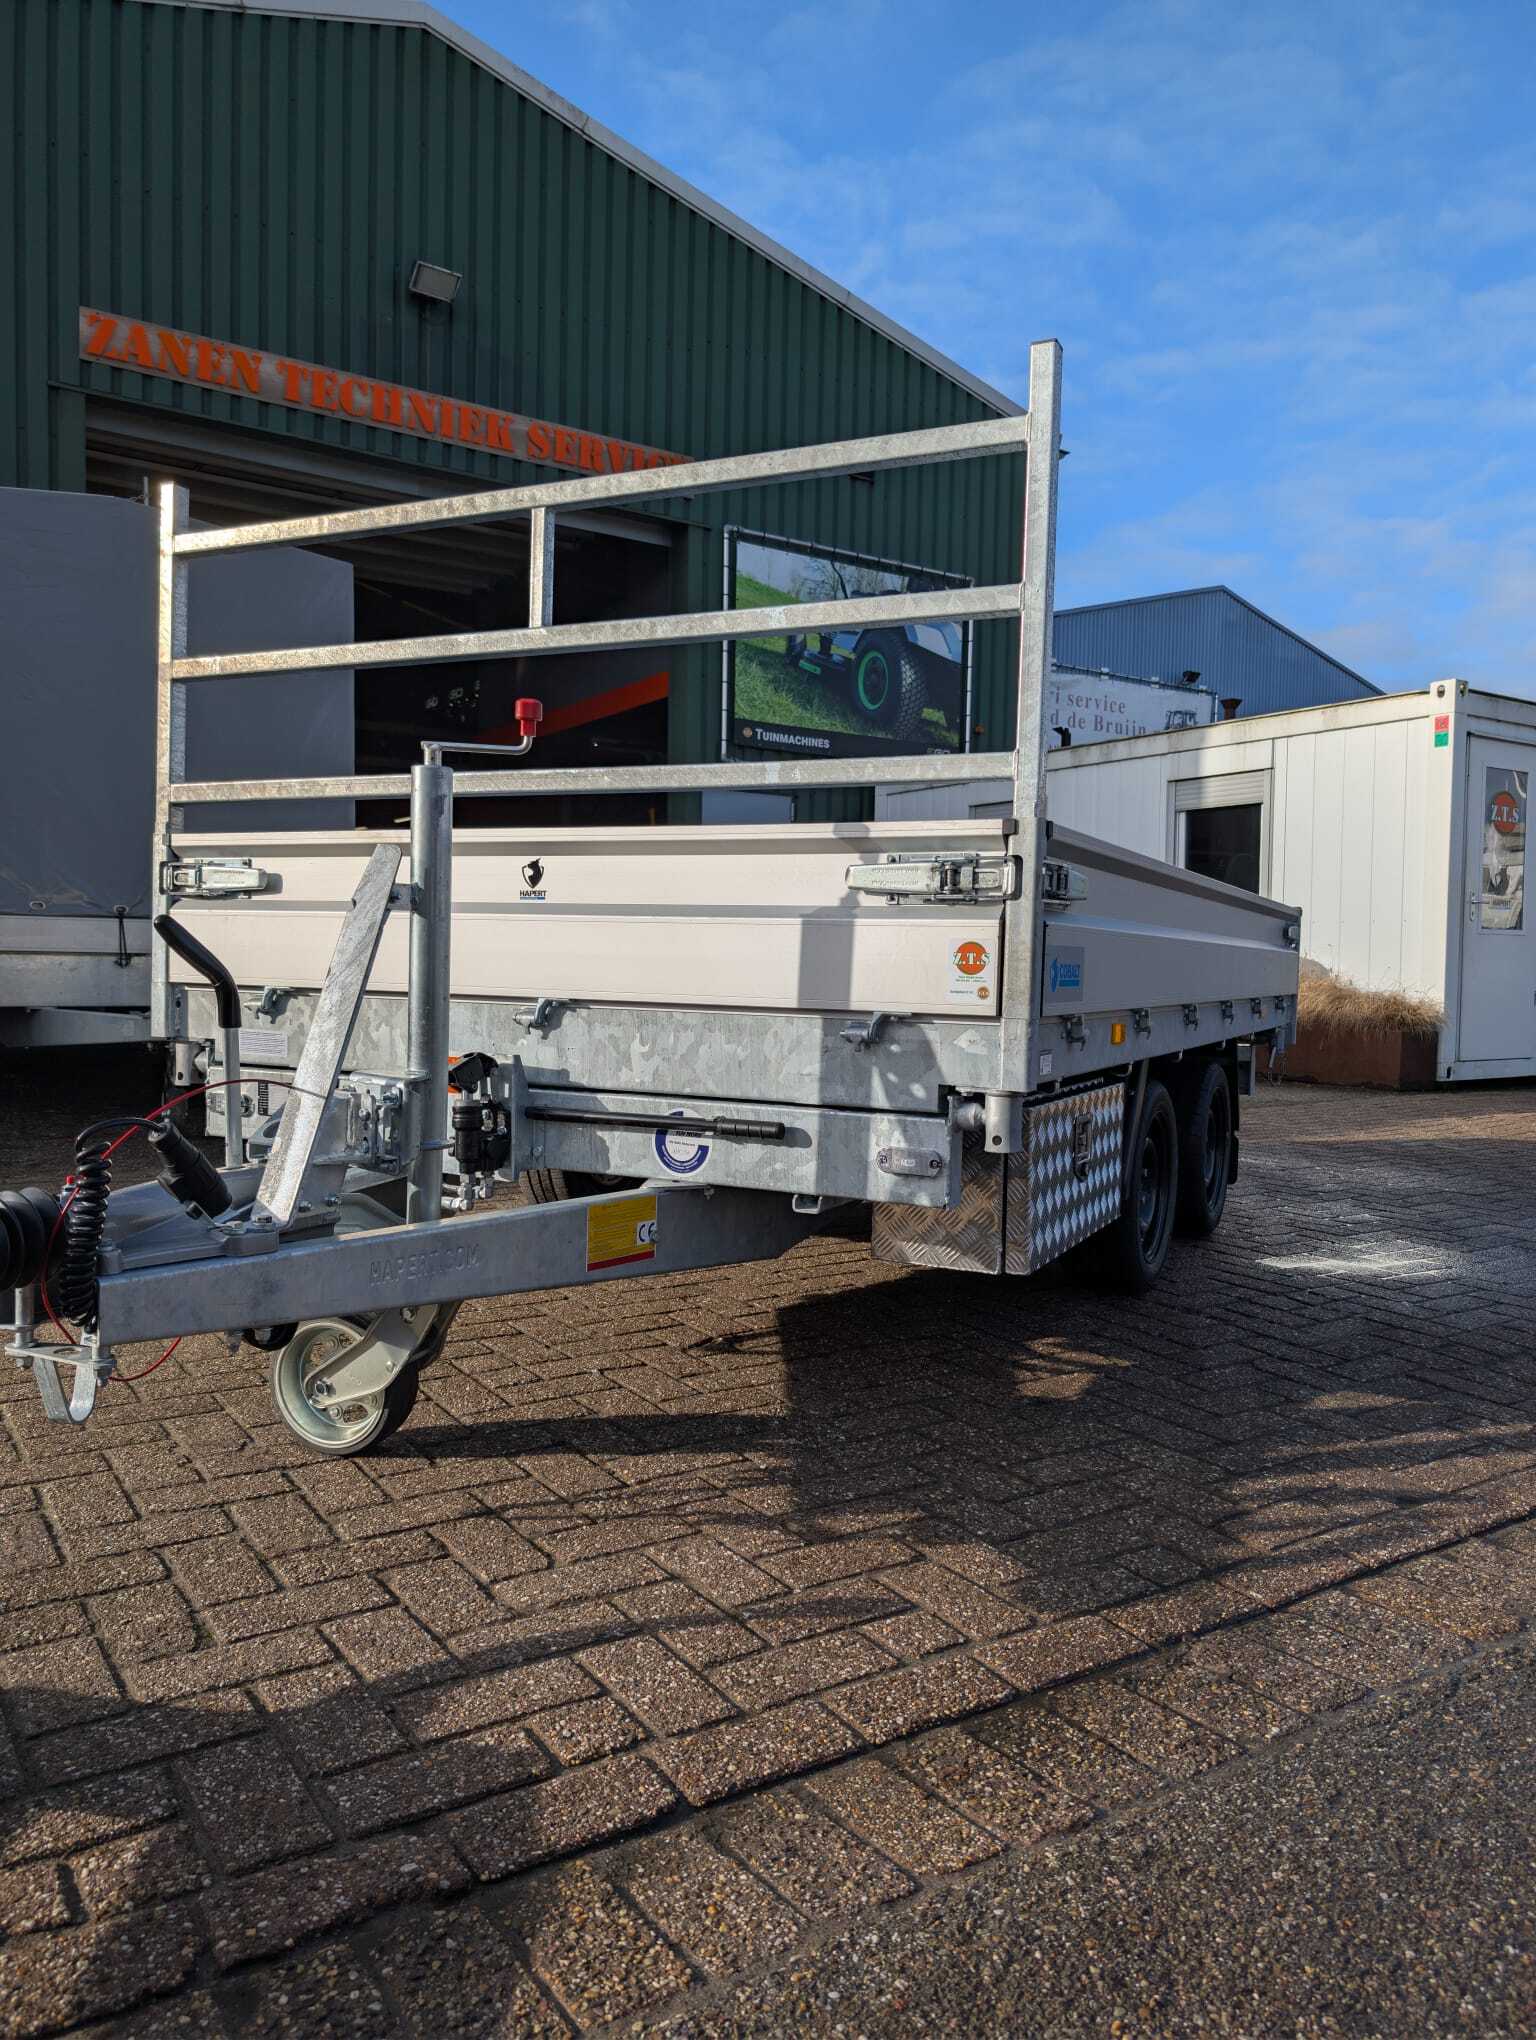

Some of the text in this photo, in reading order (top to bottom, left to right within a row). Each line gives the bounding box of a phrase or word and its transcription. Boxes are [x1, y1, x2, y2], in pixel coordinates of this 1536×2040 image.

[84, 312, 694, 475] ZANEN TECHNIEK SERVIC
[1067, 693, 1126, 715] service
[1067, 711, 1086, 729] de
[1093, 714, 1147, 737] Bruijn
[755, 728, 831, 749] TUINMACHINES
[1491, 804, 1520, 823] Z.T.S
[952, 951, 991, 966] Z.T.S
